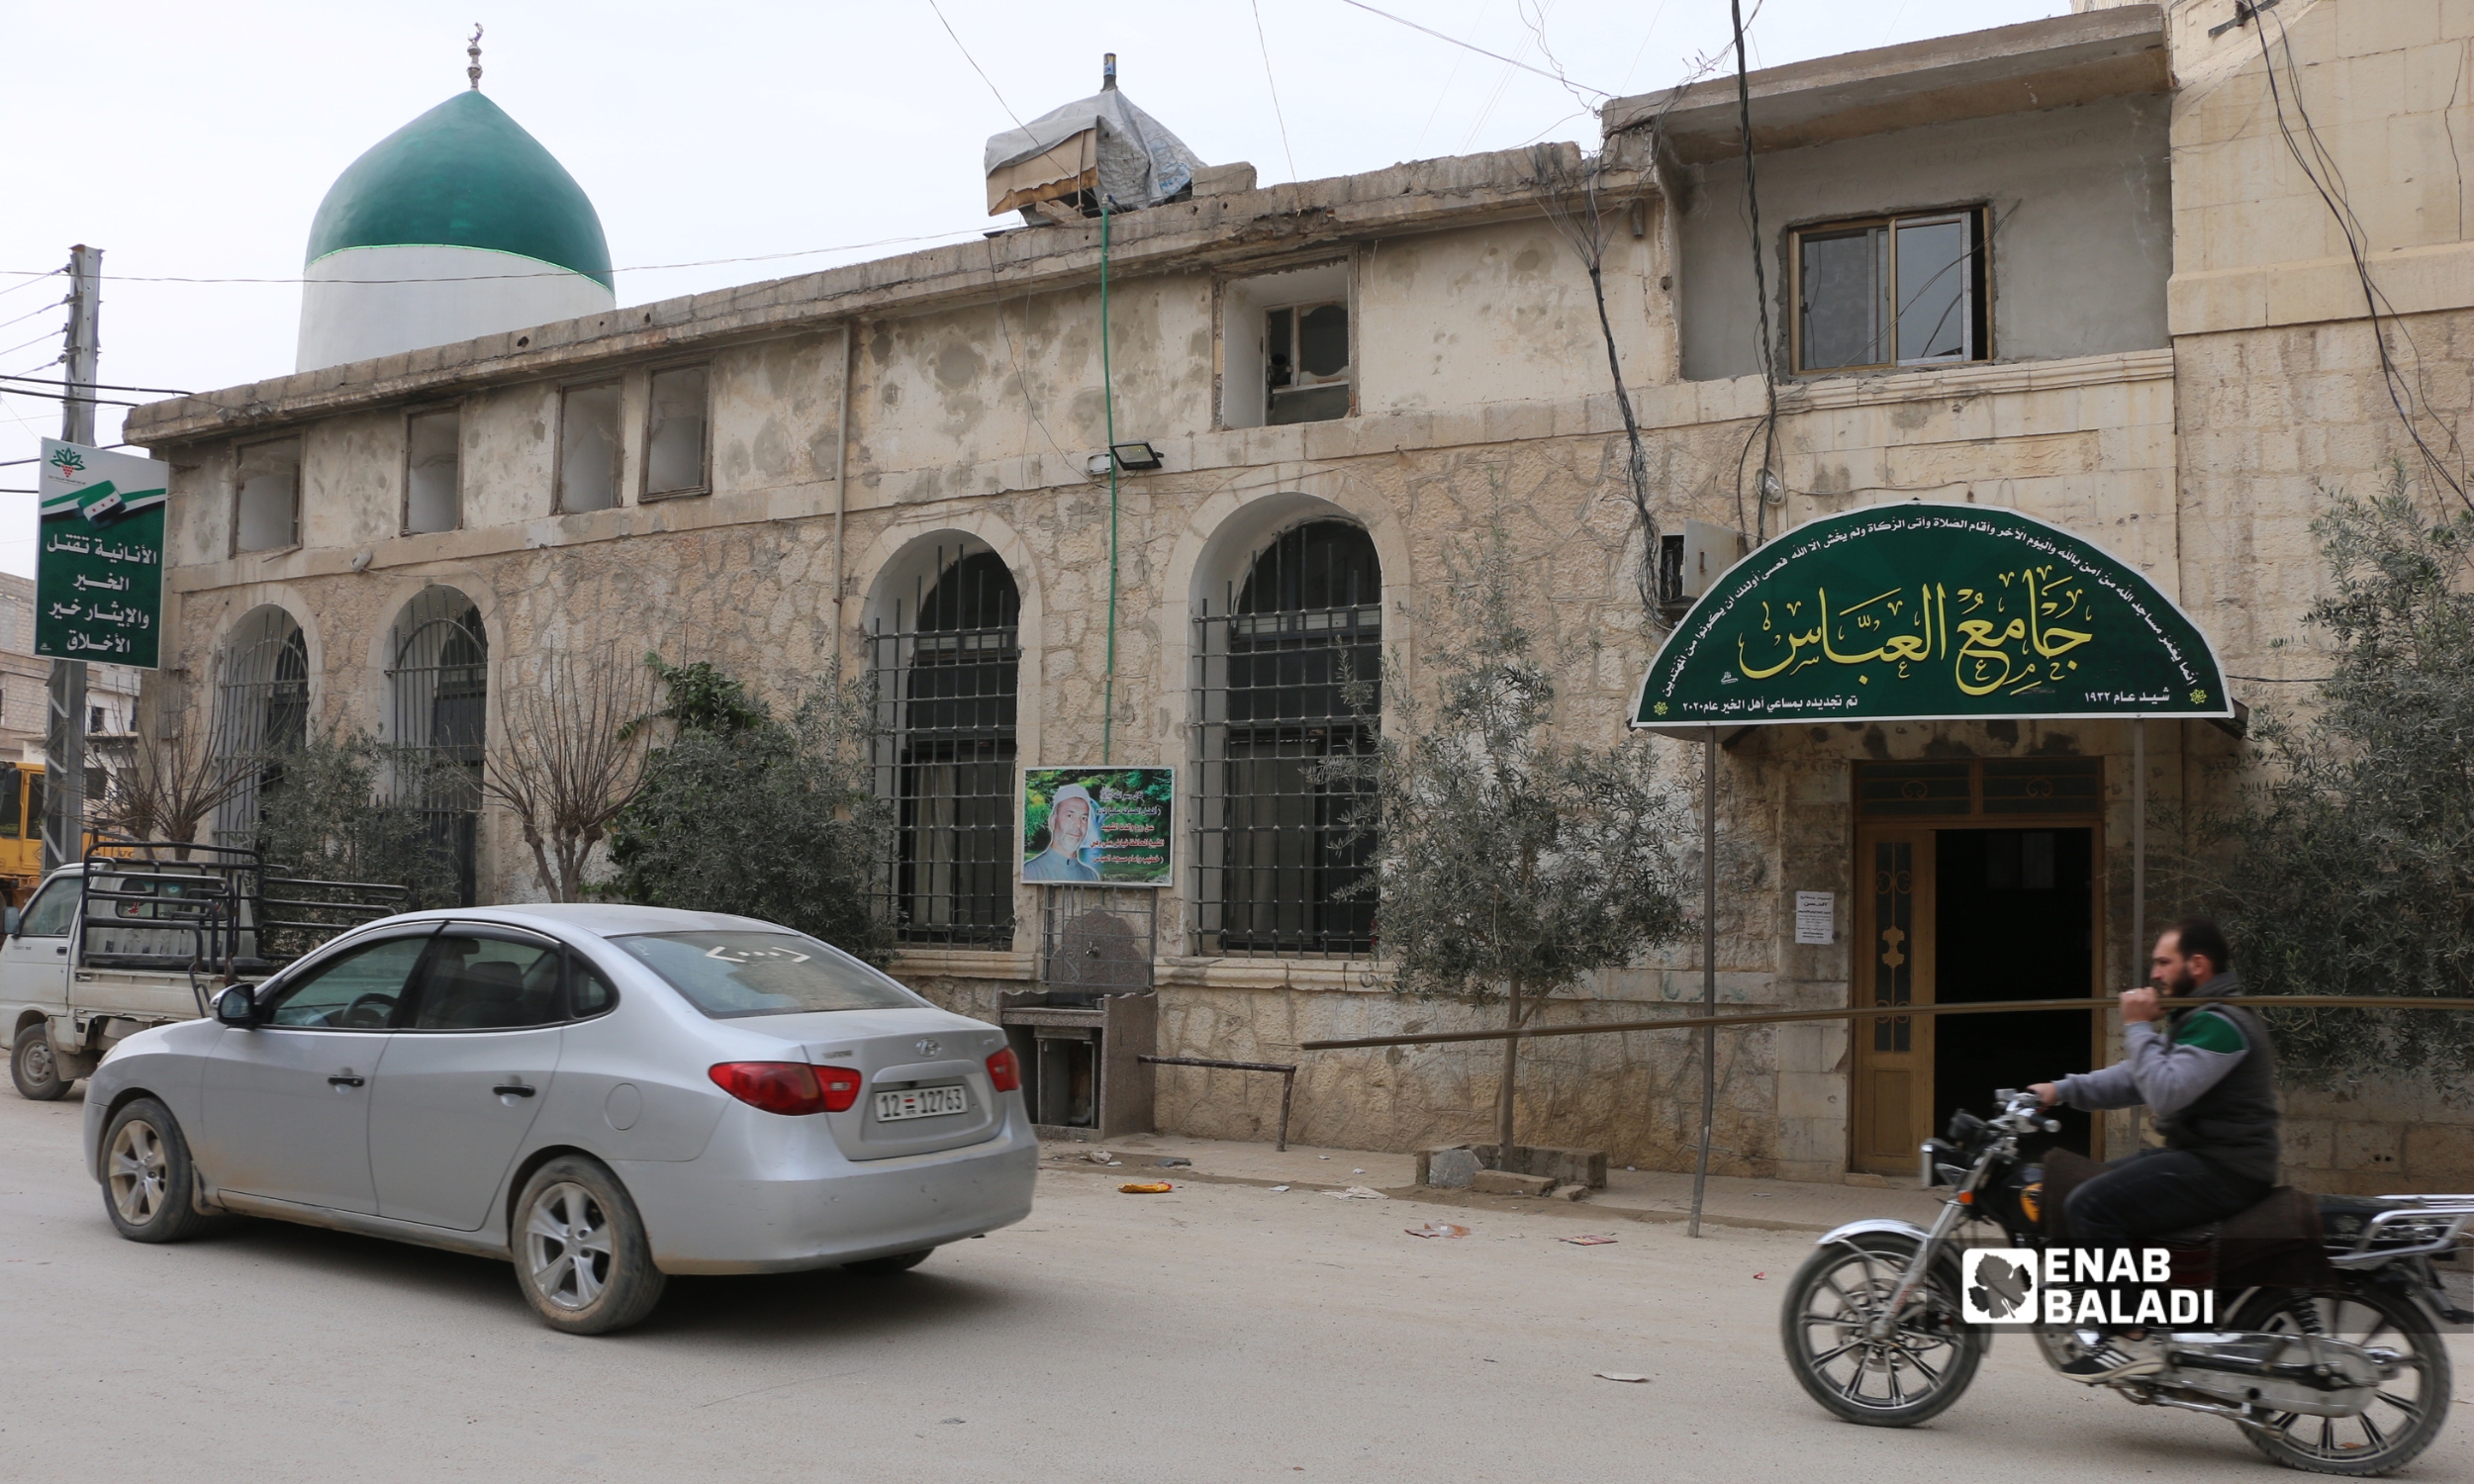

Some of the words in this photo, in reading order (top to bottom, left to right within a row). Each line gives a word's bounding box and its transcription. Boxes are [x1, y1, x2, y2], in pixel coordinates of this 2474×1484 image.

[47, 532, 90, 554] تقتل
[48, 598, 82, 620] خير
[1720, 698, 1746, 714] الخير
[1846, 695, 1858, 709] تم
[2113, 691, 2137, 705] عام
[881, 1094, 902, 1118] 12
